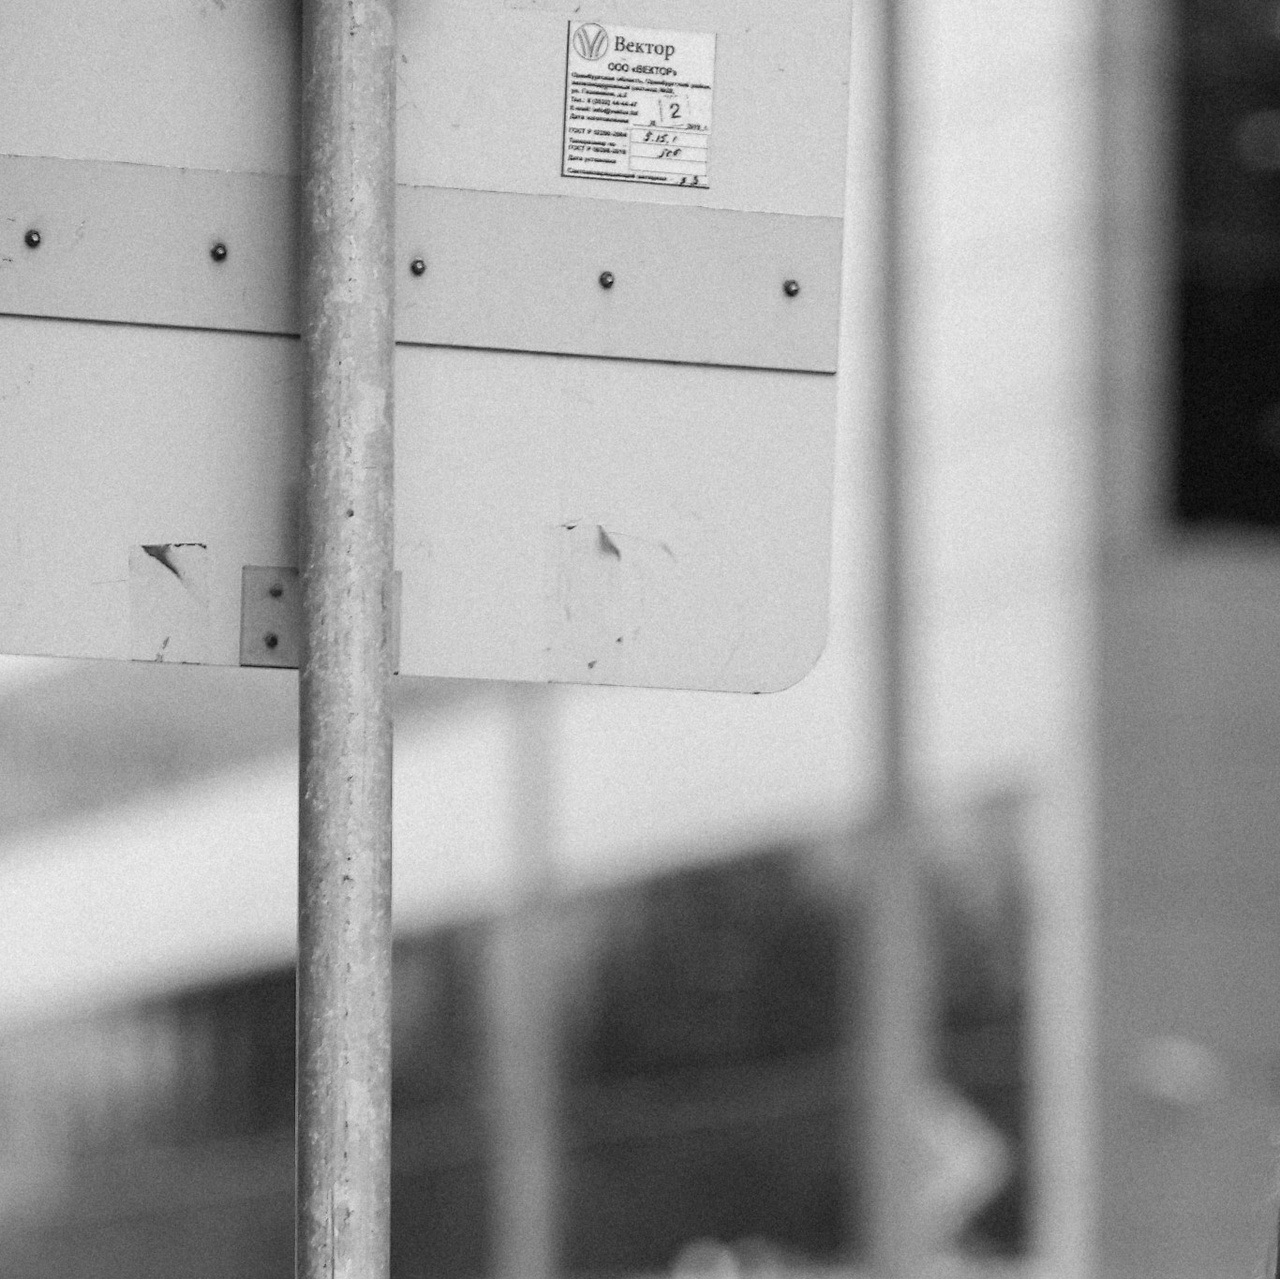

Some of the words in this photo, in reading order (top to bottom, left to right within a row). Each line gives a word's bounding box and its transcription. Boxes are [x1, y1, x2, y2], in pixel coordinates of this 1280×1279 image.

[614, 36, 675, 60] Вектор
[608, 62, 629, 73] ООО
[670, 103, 682, 119] 2
